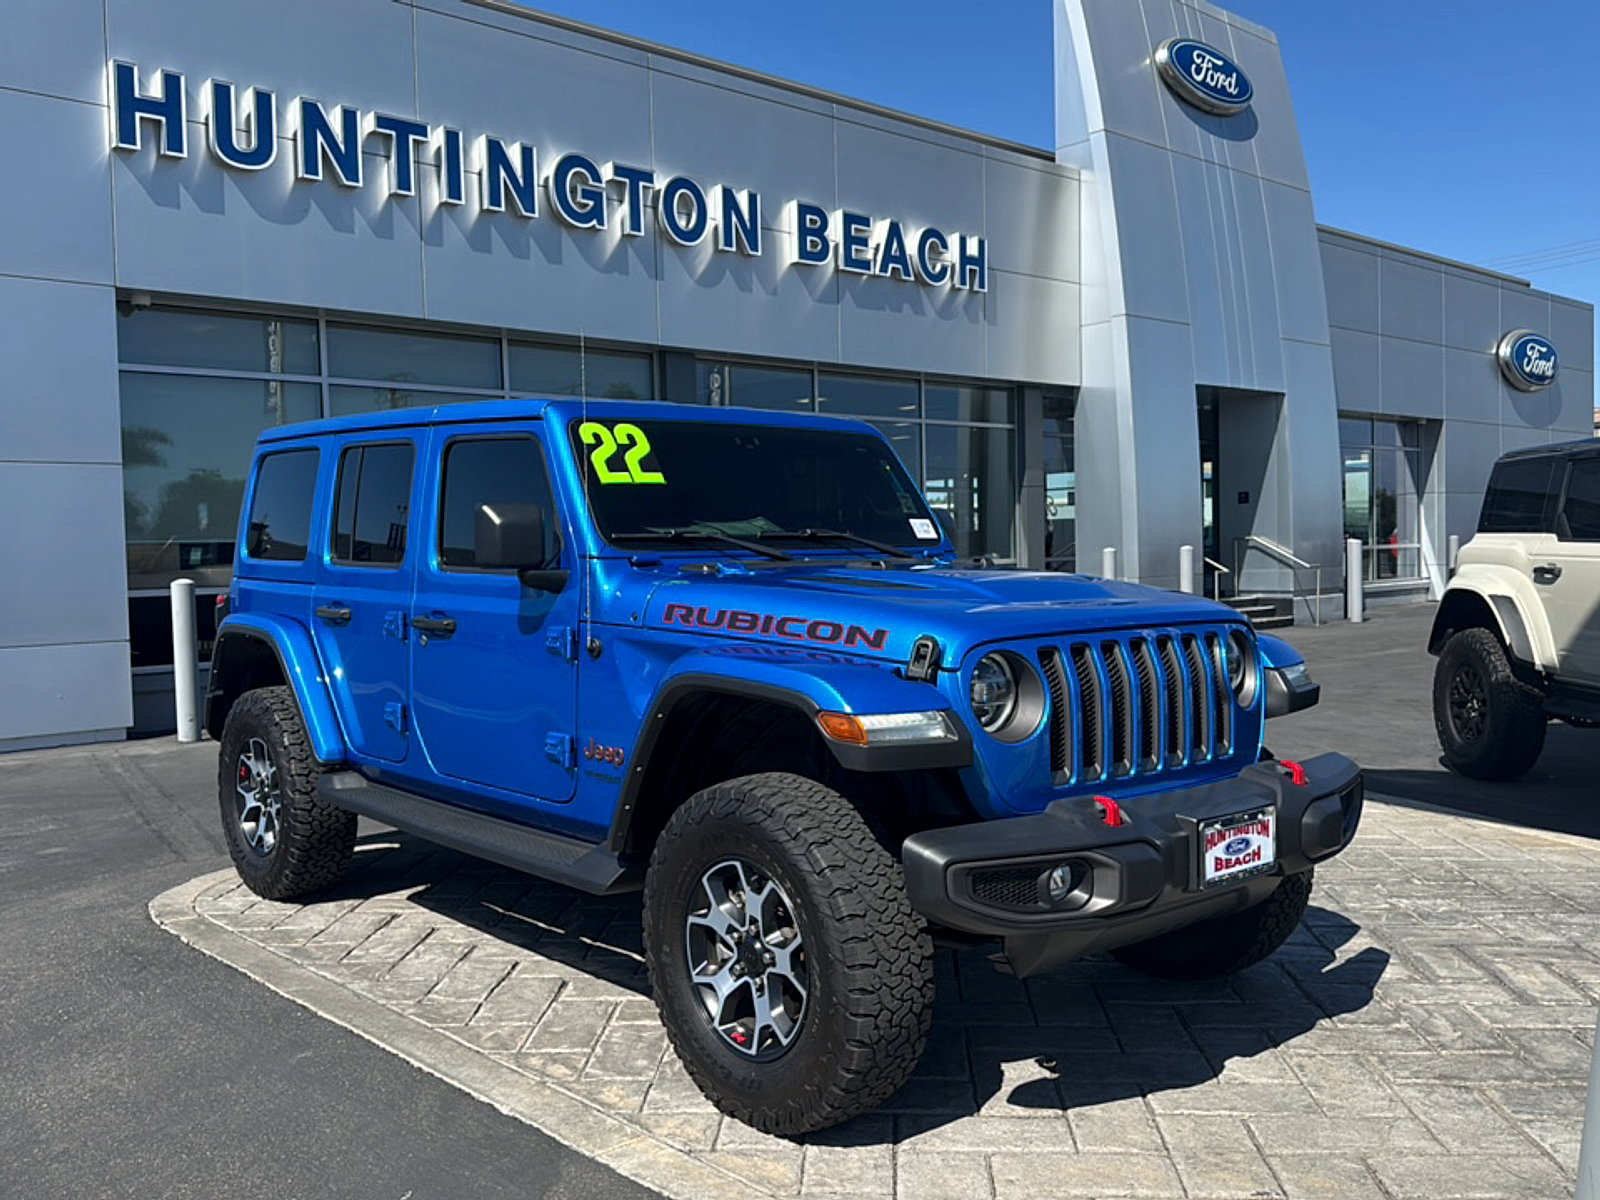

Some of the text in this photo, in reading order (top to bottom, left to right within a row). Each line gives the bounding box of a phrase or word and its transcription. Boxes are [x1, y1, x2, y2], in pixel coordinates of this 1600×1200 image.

[1190, 49, 1240, 95] Ford
[110, 59, 988, 293] HUNTINGTON BEACH
[1523, 342, 1555, 378] Ford
[578, 422, 667, 485] 22
[663, 603, 890, 652] RUBICON
[583, 736, 624, 769] Jeep
[1205, 818, 1270, 854] HUNTINGTON
[1214, 844, 1261, 873] BEACH
